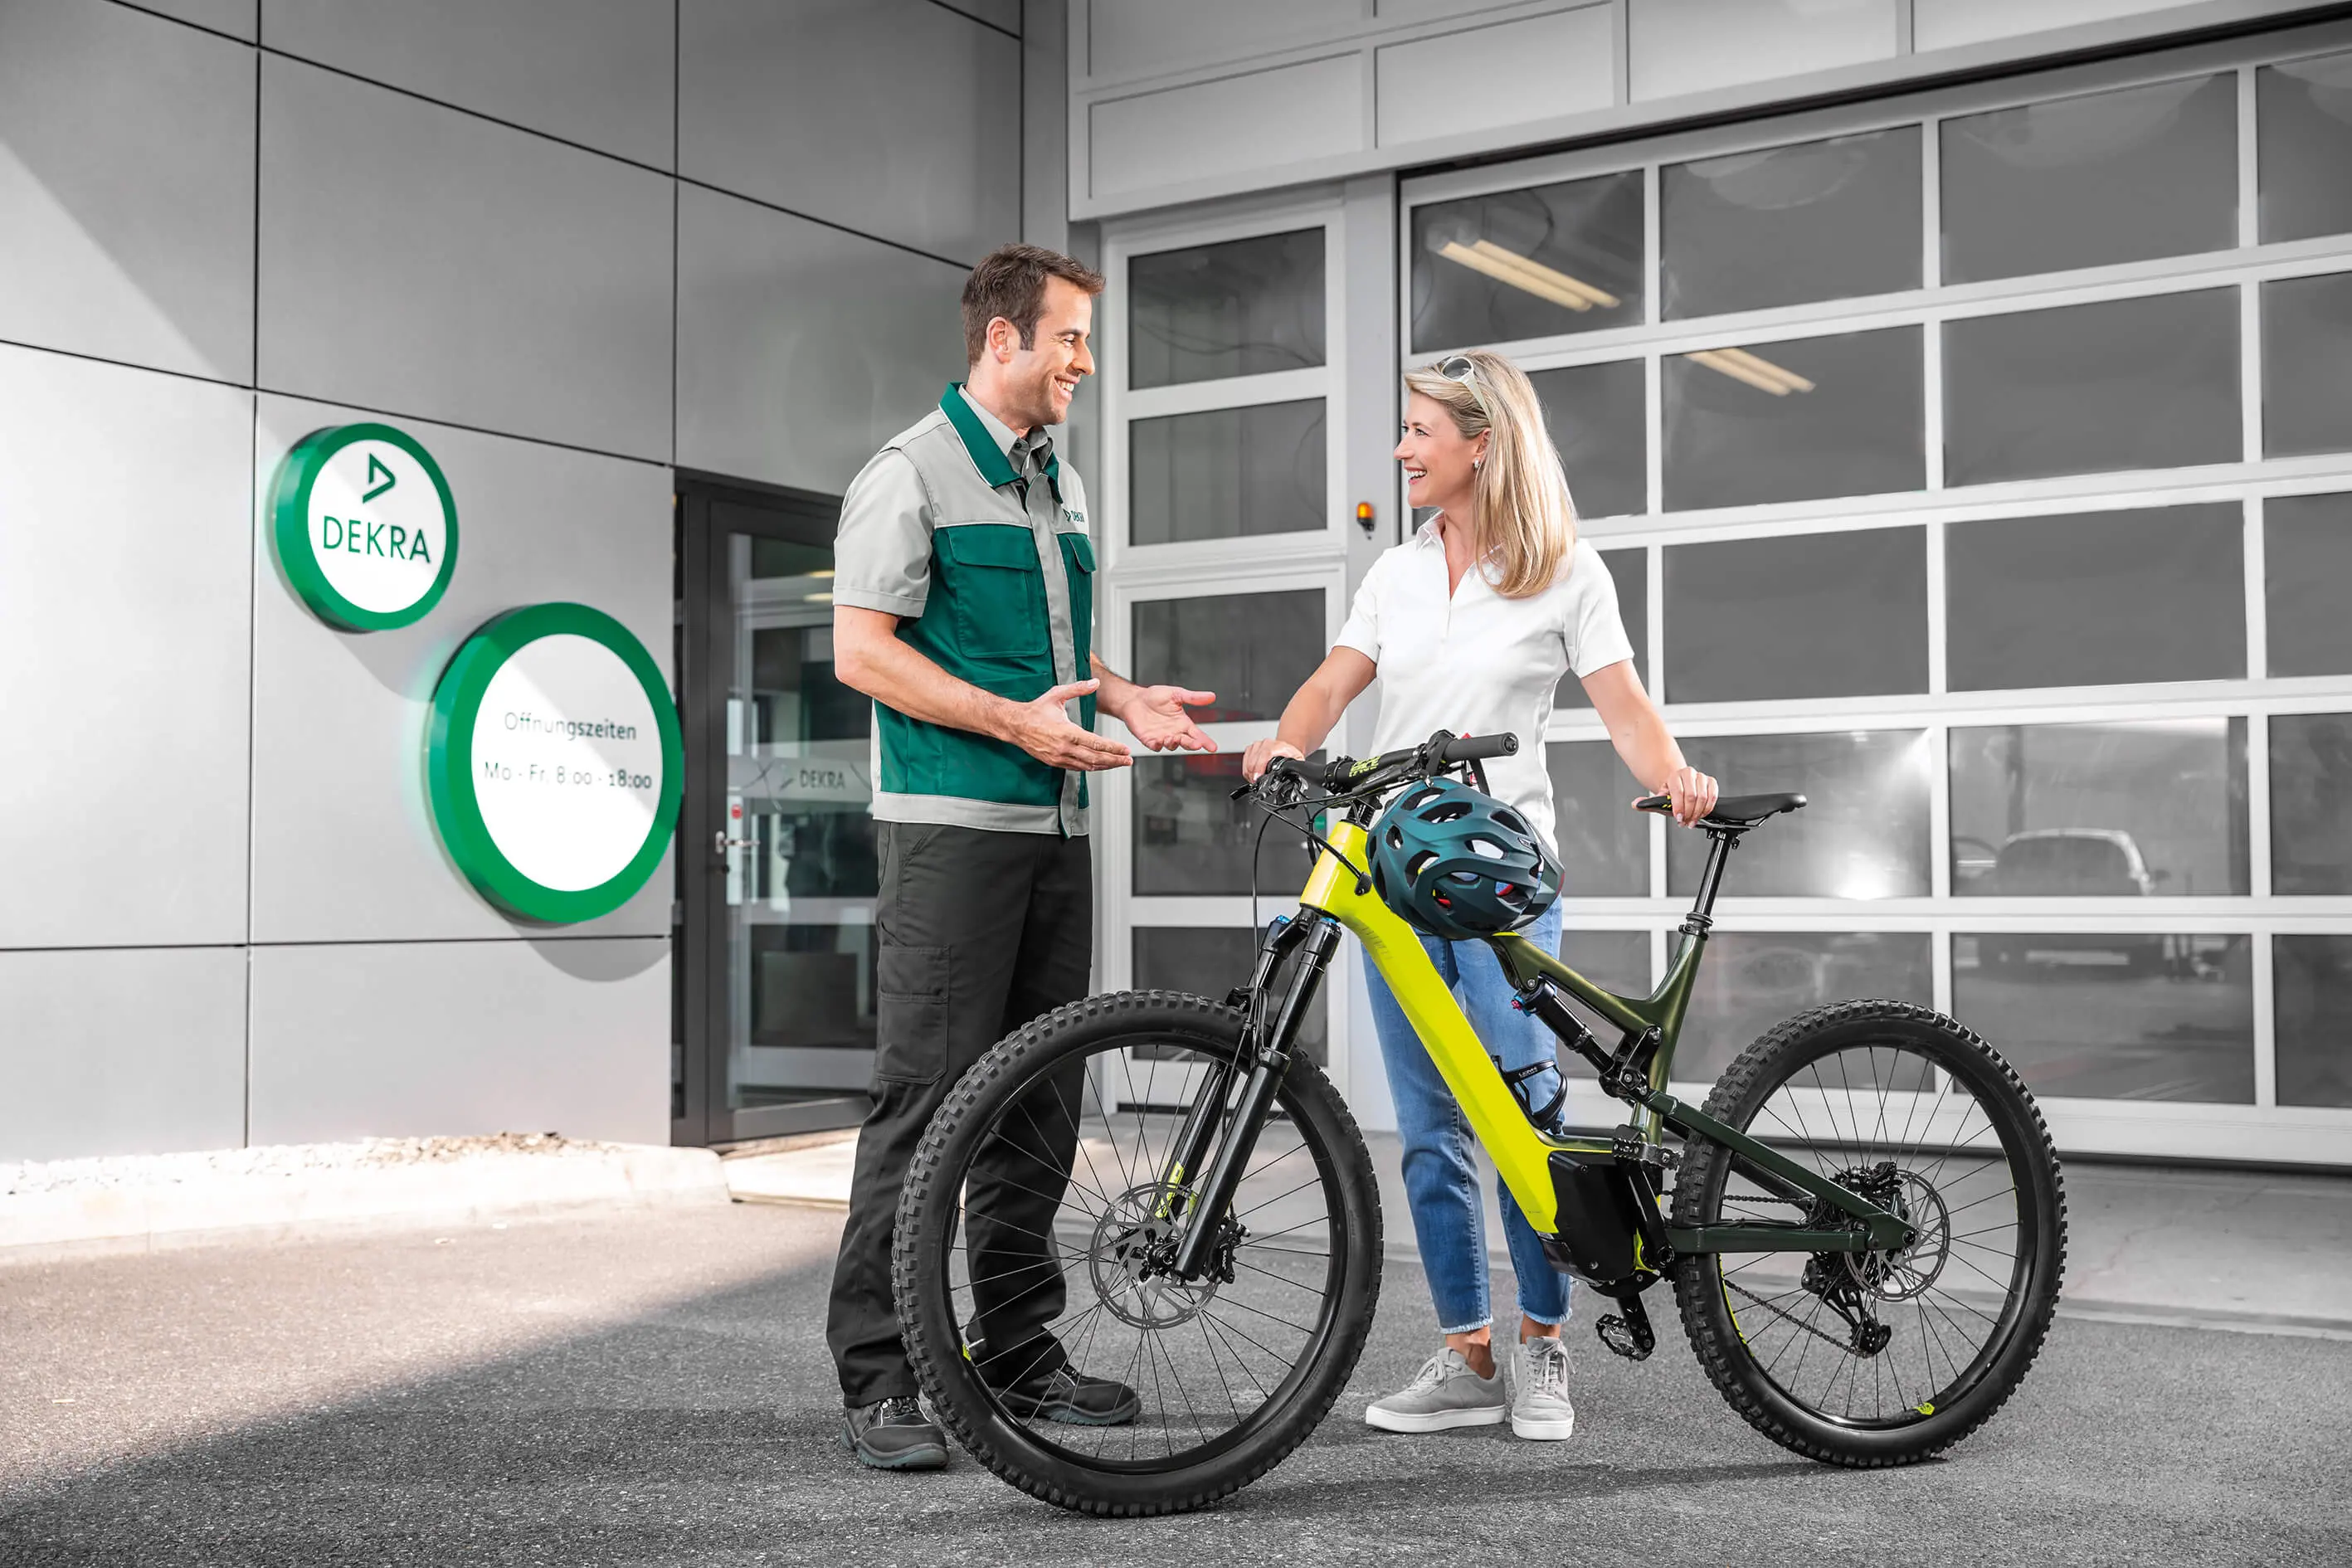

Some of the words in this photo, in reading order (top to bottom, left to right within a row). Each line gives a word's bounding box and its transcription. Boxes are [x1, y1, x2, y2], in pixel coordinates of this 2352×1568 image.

[324, 515, 431, 564] DEKRA
[485, 762, 512, 782] Mo
[608, 768, 653, 789] 18:00
[799, 768, 846, 789] DEKRA
